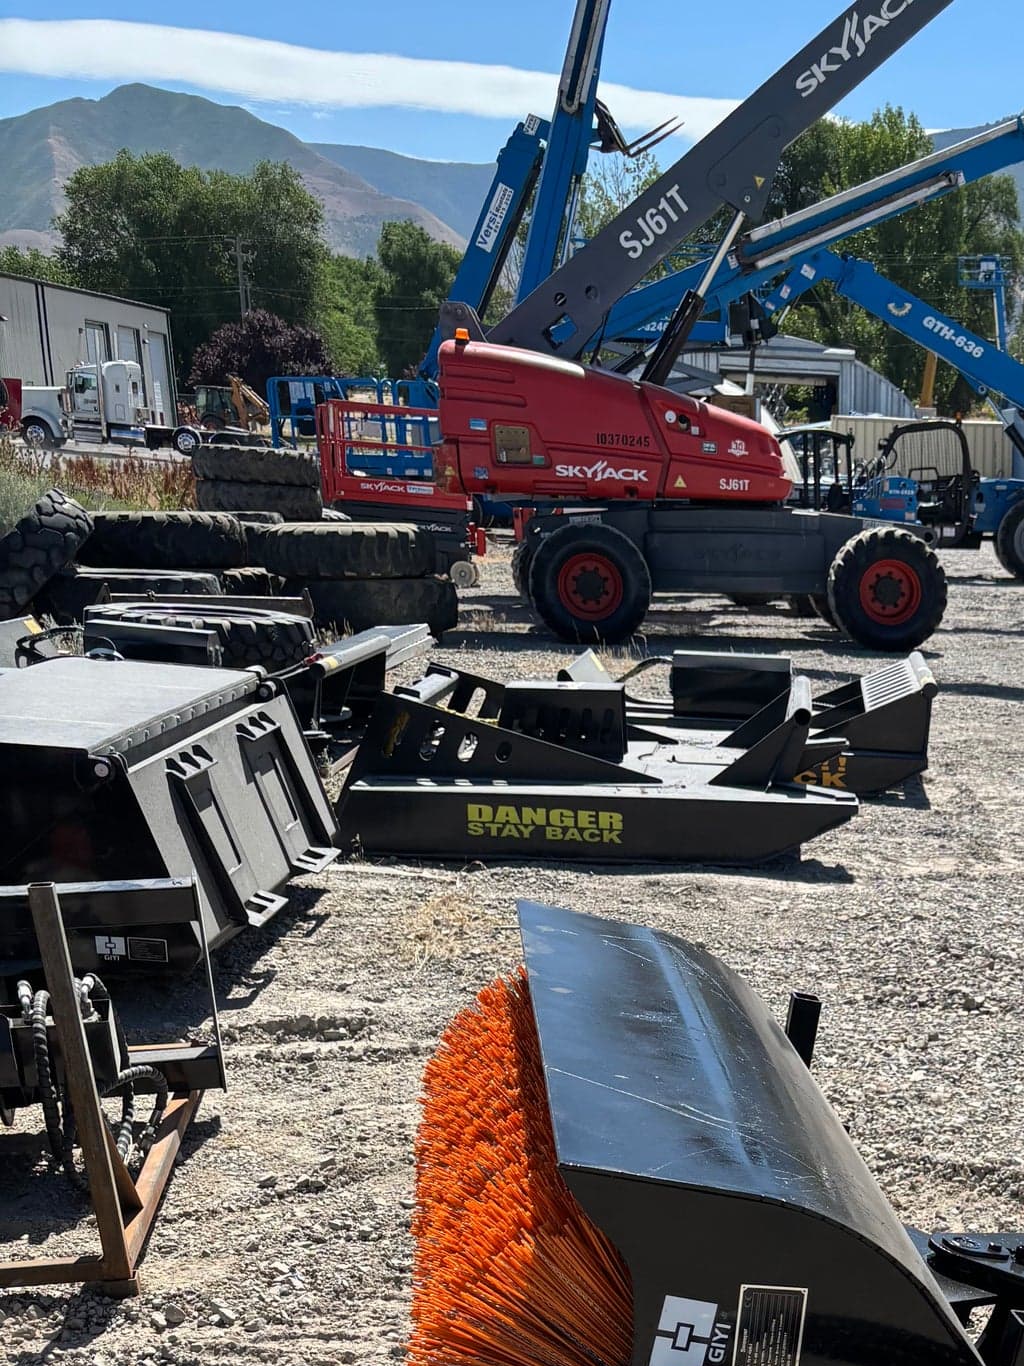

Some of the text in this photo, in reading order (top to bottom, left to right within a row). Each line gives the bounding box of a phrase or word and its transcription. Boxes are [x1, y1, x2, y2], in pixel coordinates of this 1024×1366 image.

[796, 0, 914, 98] SKYJAC
[477, 210, 499, 247] Versi
[619, 184, 689, 259] SJ61T
[922, 316, 985, 358] GTH-636
[555, 460, 649, 482] SKYJACK
[719, 478, 750, 491] SJ61T
[360, 481, 406, 493] SKYJACK
[420, 523, 452, 532] KYJACK
[467, 803, 624, 830] DANGER
[467, 822, 623, 844] STAY BACK
[708, 1322, 732, 1364] GIYI
